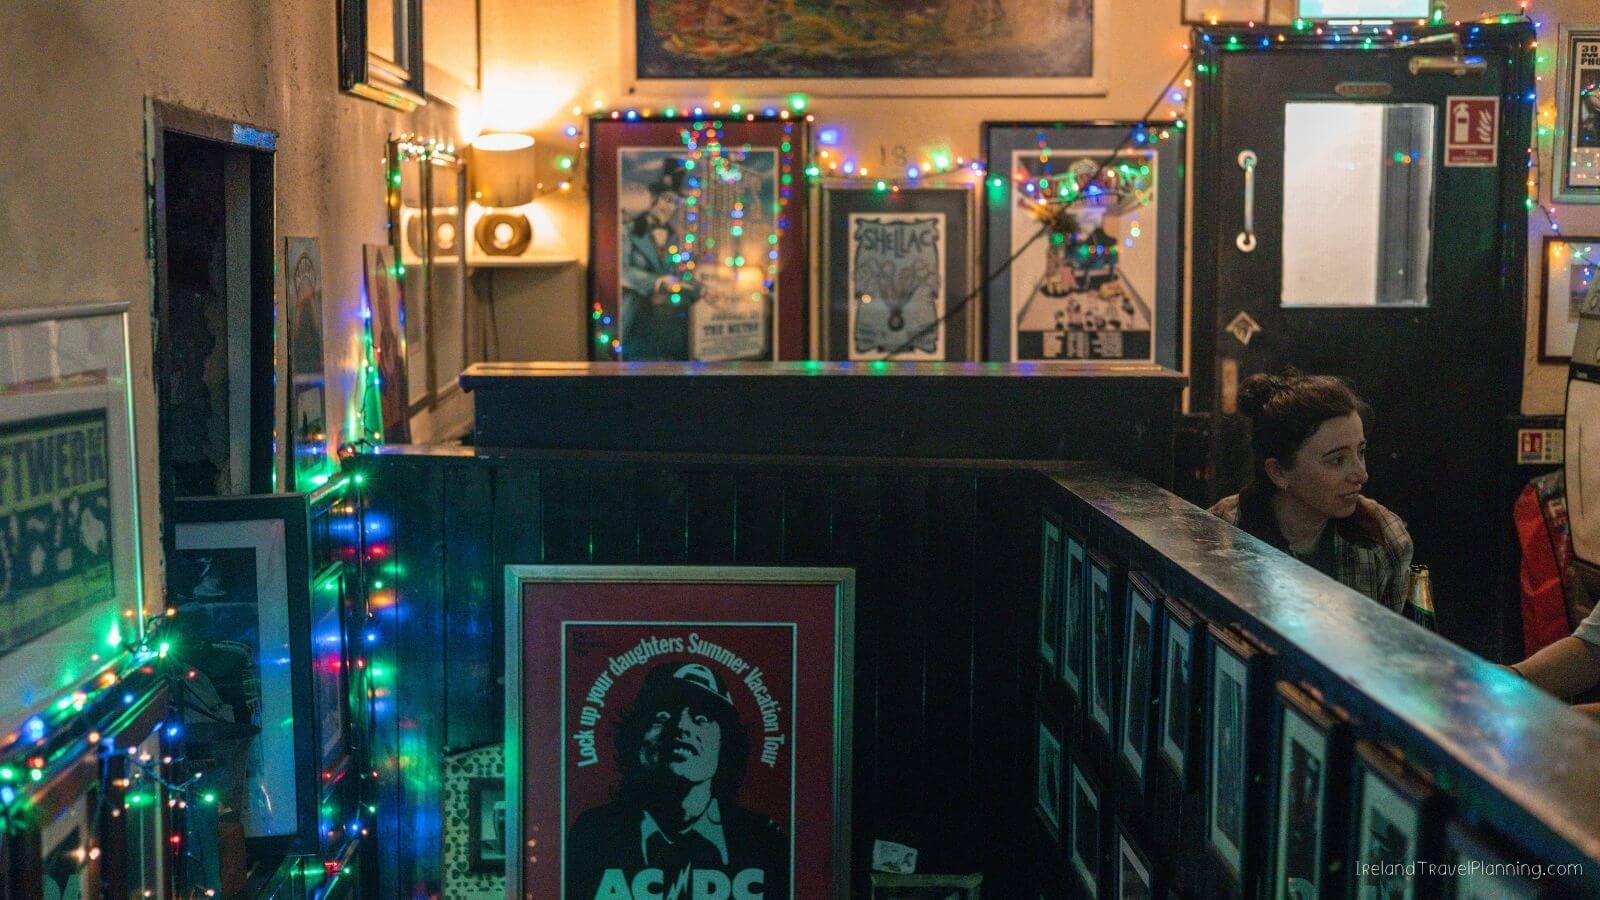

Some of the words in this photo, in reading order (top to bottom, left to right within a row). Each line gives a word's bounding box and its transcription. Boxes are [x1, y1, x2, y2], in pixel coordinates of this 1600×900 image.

[862, 226, 931, 259] SHELLAC
[608, 635, 684, 677] daughters
[687, 632, 750, 675] Summer
[586, 670, 614, 708] your
[744, 666, 782, 732] Vacation
[580, 705, 601, 727] up
[574, 728, 599, 767] Lock
[760, 733, 785, 768] Tour
[593, 852, 765, 900] AC/DC
